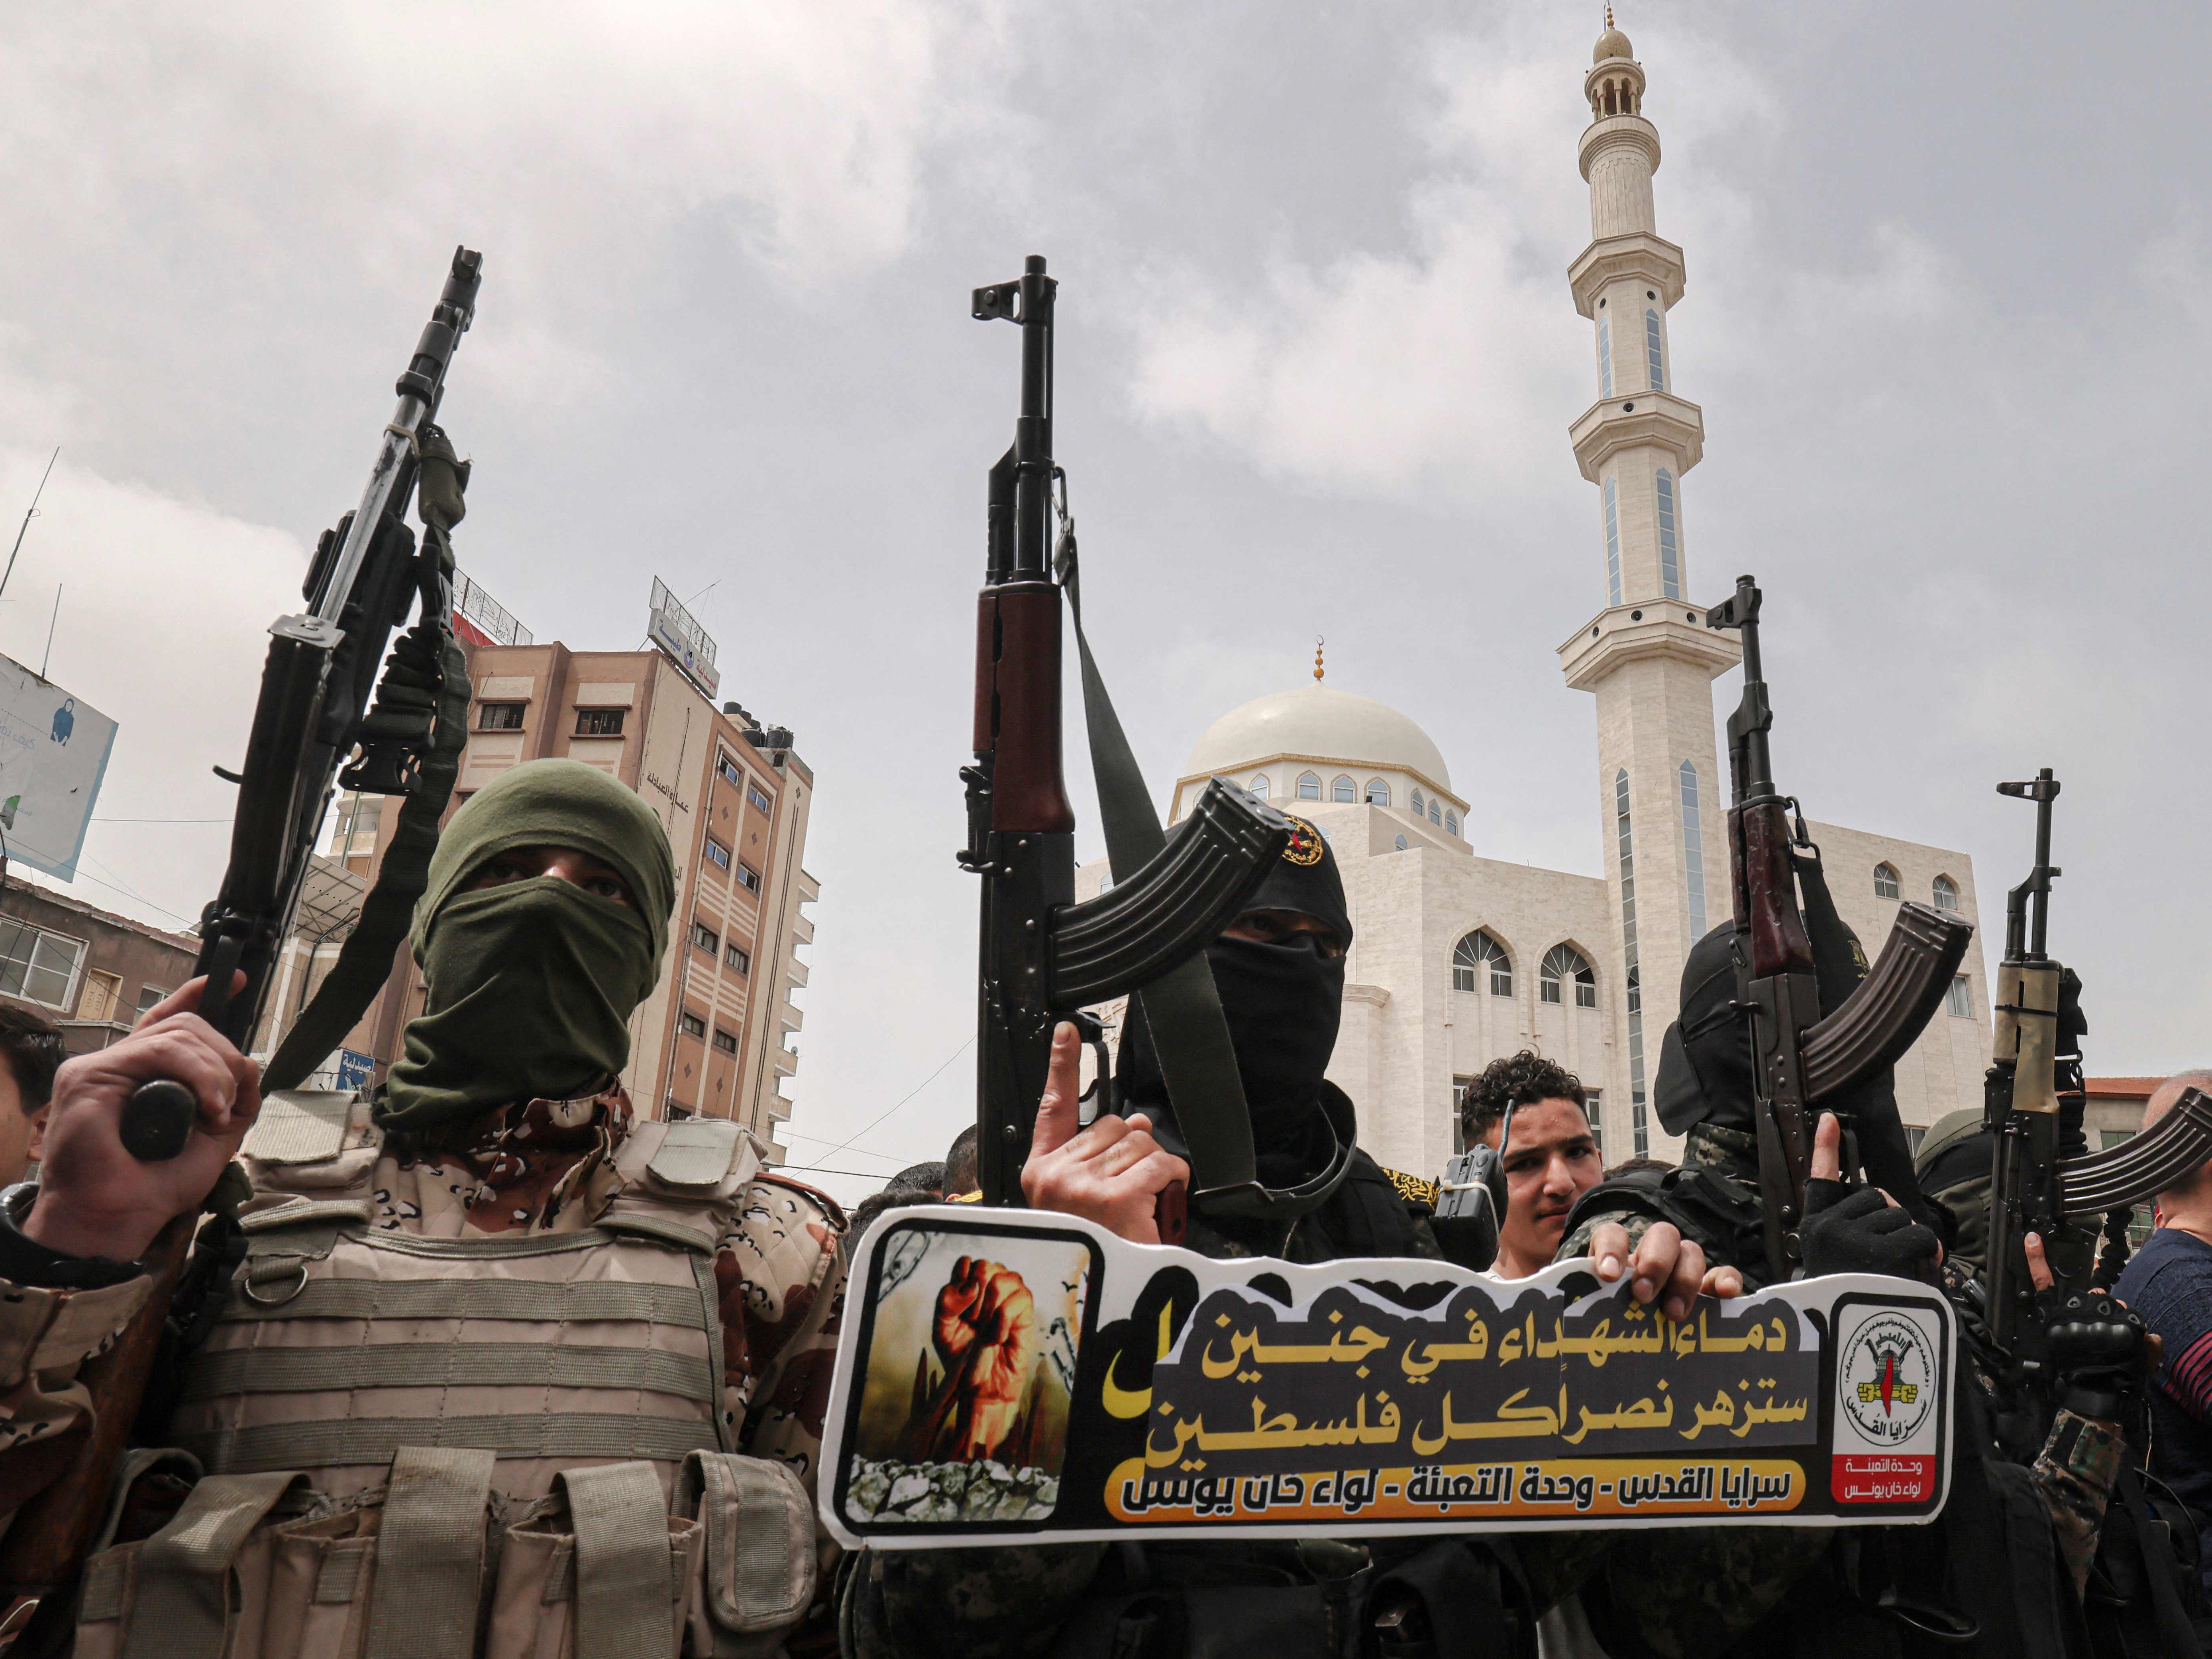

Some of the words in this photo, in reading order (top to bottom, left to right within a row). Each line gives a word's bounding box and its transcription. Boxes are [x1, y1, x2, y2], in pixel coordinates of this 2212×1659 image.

[659, 618, 681, 652] طيبة
[696, 658, 717, 690] صيدلية
[646, 770, 670, 797] العبادلة
[669, 788, 689, 813] عمارة
[343, 1053, 371, 1074] صيدلية
[1201, 1310, 1390, 1384] جنين
[1401, 1308, 1488, 1384] في
[1498, 1300, 1676, 1367] الشهداء
[1675, 1308, 1787, 1361] دماء
[1411, 1388, 1559, 1456] كل
[1679, 1378, 1807, 1440] ستزهر
[1144, 1390, 1401, 1472] فلسطين
[1617, 1465, 1713, 1507] القدس
[1720, 1465, 1791, 1509] سرايا
[1845, 1457, 1890, 1475] التعبئة
[1890, 1459, 1922, 1475] وحدة
[1311, 1469, 1381, 1514] لواء
[1405, 1465, 1513, 1513] التعبئة
[1518, 1466, 1594, 1512] وحدة
[1845, 1482, 1885, 1499] يونس
[1885, 1481, 1902, 1498] خان
[1903, 1481, 1921, 1498] لواء
